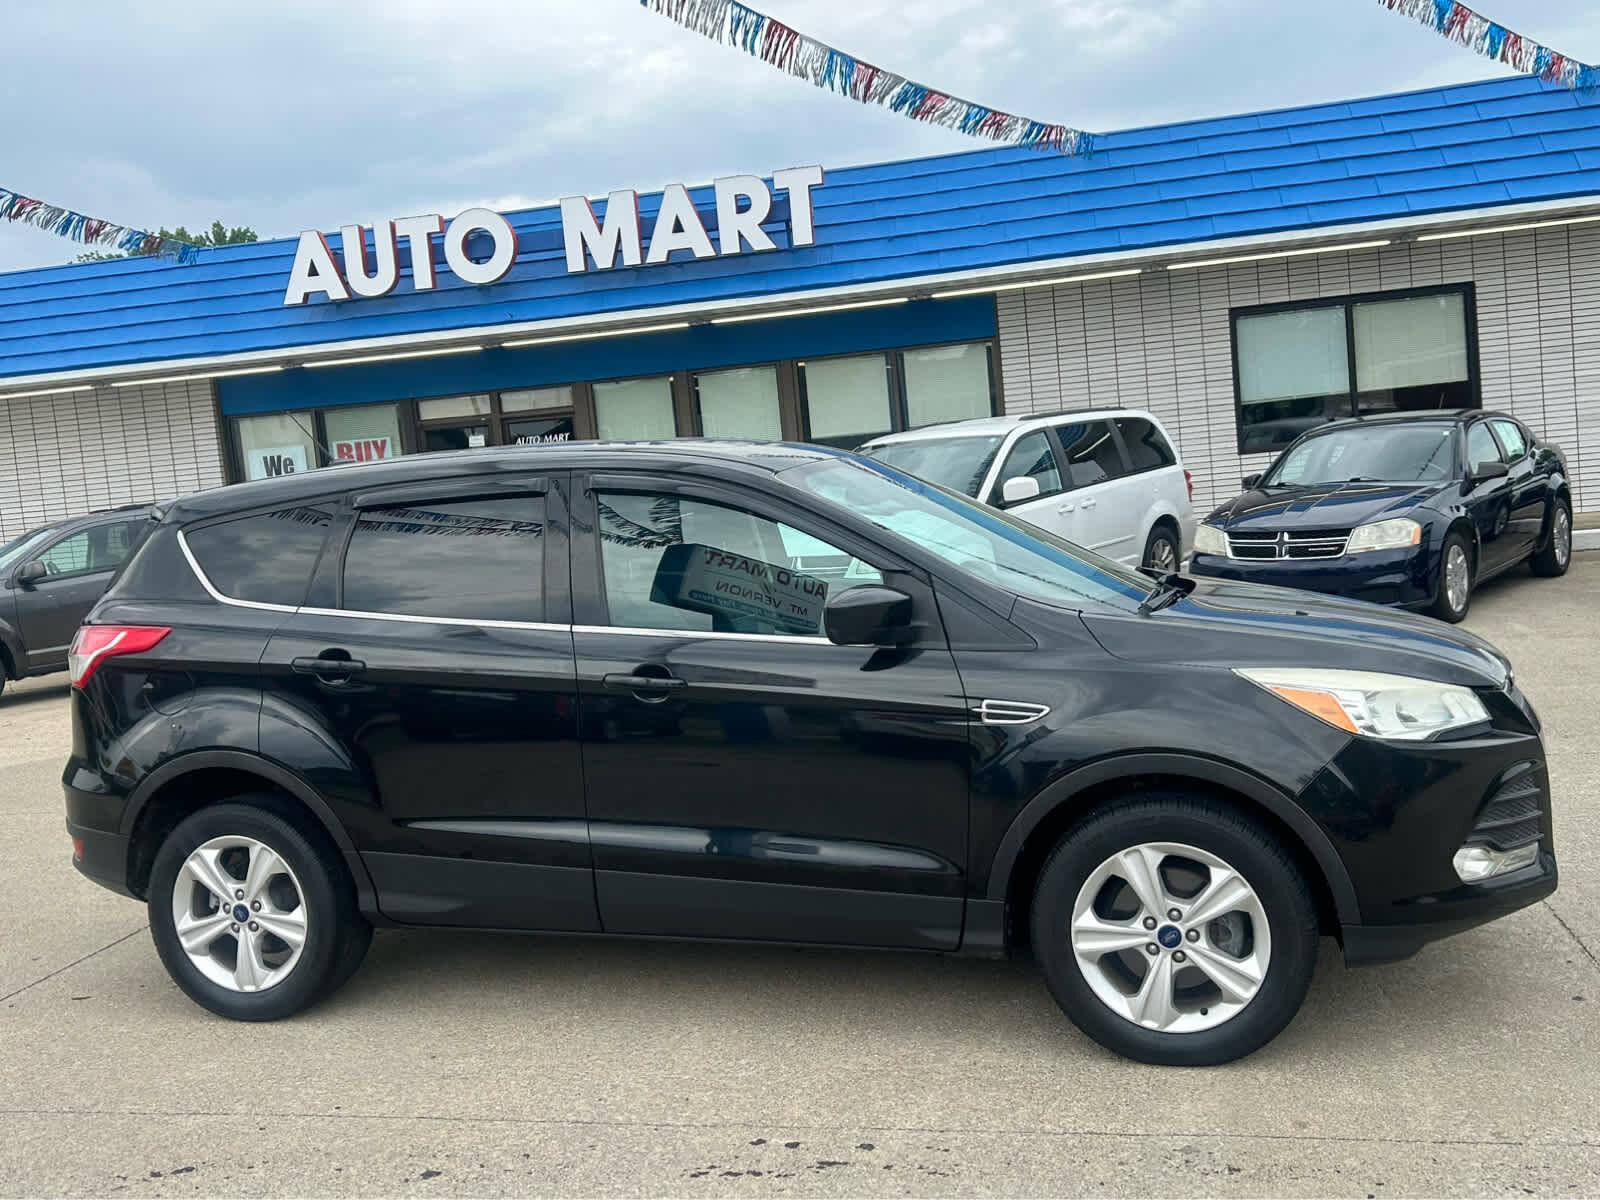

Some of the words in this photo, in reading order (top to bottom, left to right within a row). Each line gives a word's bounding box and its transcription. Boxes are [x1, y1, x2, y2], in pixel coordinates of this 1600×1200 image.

[283, 207, 519, 306] AUTO
[559, 165, 824, 274] MART
[335, 439, 387, 462] BUY
[515, 435, 541, 447] AUTO
[543, 432, 570, 444] MART
[262, 455, 295, 477] We
